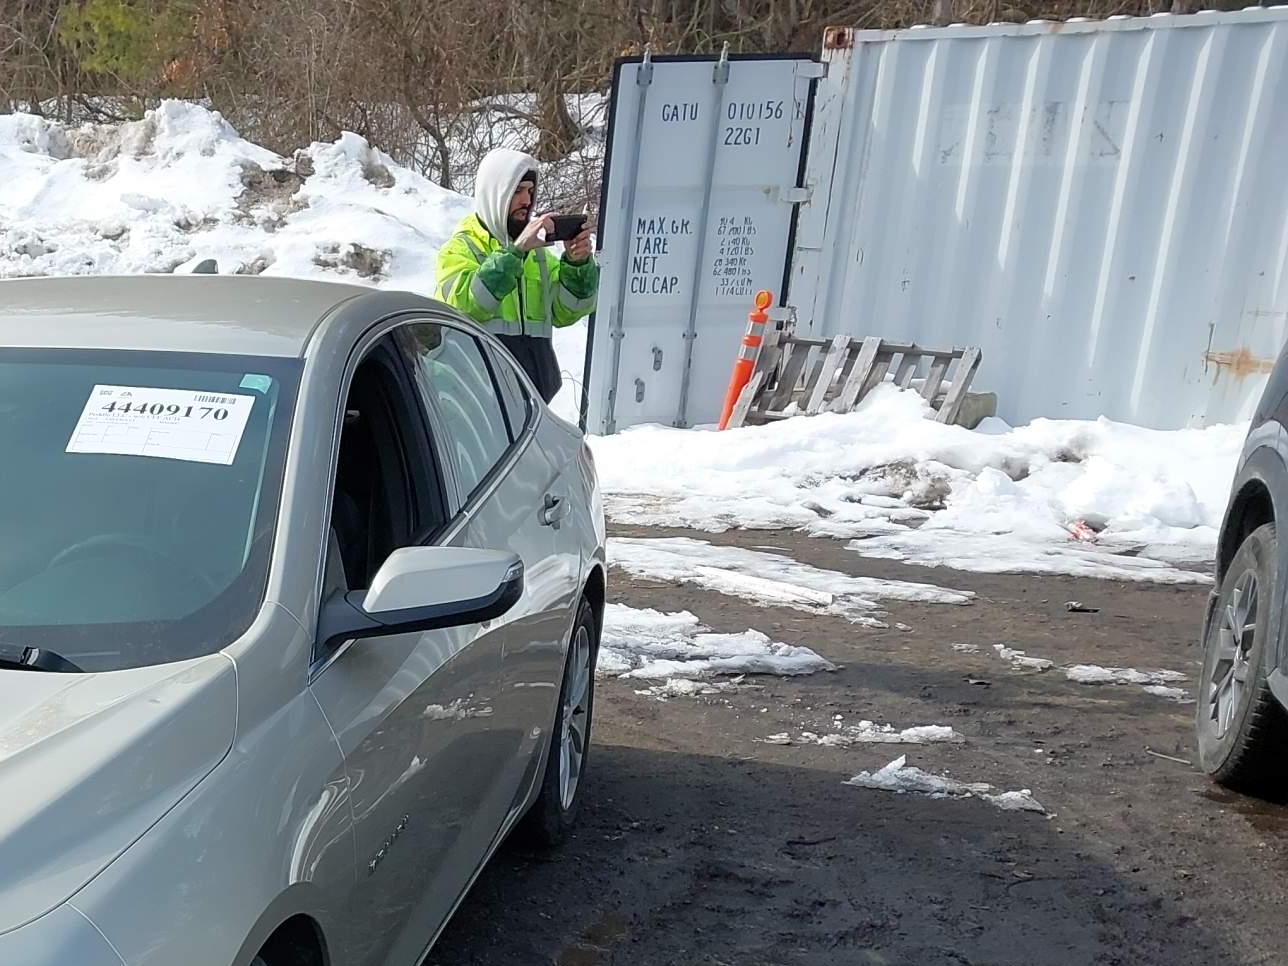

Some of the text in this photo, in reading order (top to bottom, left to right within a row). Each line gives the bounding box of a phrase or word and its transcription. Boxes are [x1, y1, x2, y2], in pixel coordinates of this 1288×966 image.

[661, 102, 699, 121] GATU
[724, 127, 761, 146] 22G1
[636, 237, 669, 255] TARE
[632, 256, 658, 274] NET
[101, 401, 229, 421] 44409170
